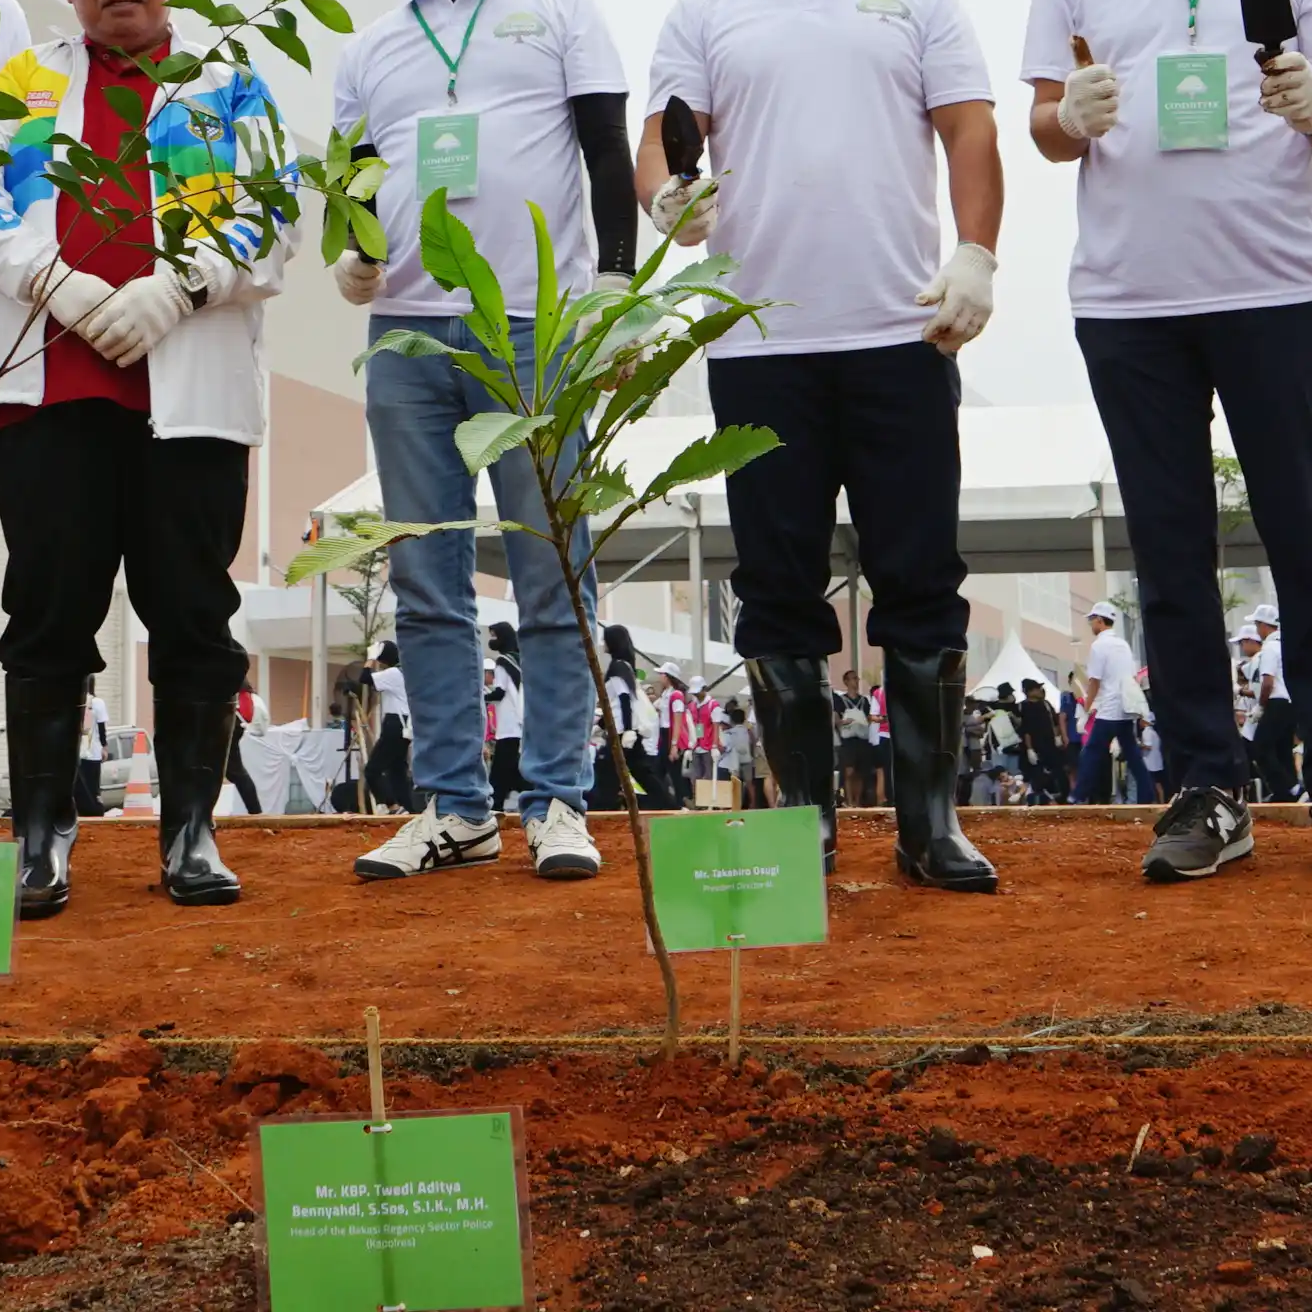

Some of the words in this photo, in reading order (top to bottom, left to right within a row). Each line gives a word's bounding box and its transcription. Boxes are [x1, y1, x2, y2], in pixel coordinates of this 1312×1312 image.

[316, 1185, 336, 1199] Mr.
[341, 1184, 370, 1197] KBP.
[373, 1181, 413, 1197] Twedi
[417, 1181, 461, 1196] Aditya
[292, 1202, 365, 1220] Bennyahdi,
[456, 1197, 489, 1212] M.H.
